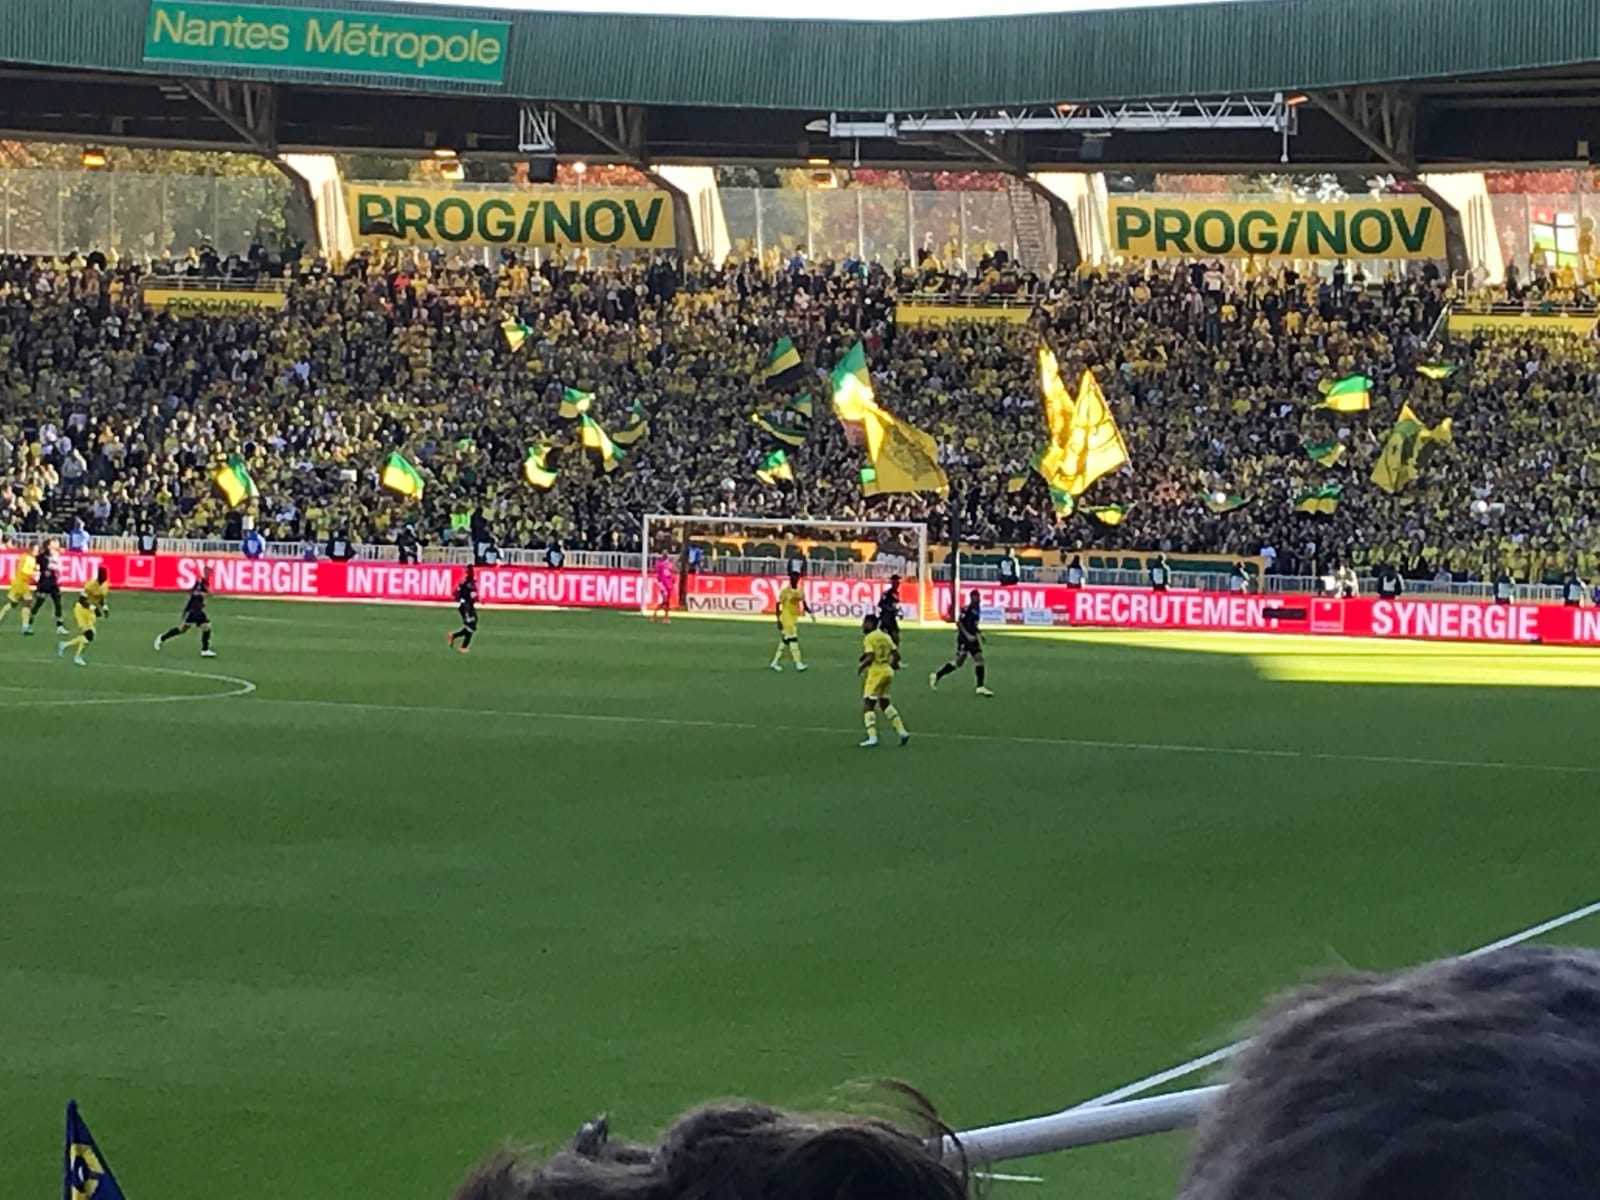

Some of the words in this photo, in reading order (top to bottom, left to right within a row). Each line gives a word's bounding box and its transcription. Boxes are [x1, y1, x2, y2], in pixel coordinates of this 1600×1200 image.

[153, 9, 290, 51] Nantes
[177, 558, 318, 593] SYNERGIE
[347, 566, 452, 597] INTERIM
[1075, 592, 1284, 628] RECRUTEMENT
[1372, 600, 1539, 640] SYNERGIE
